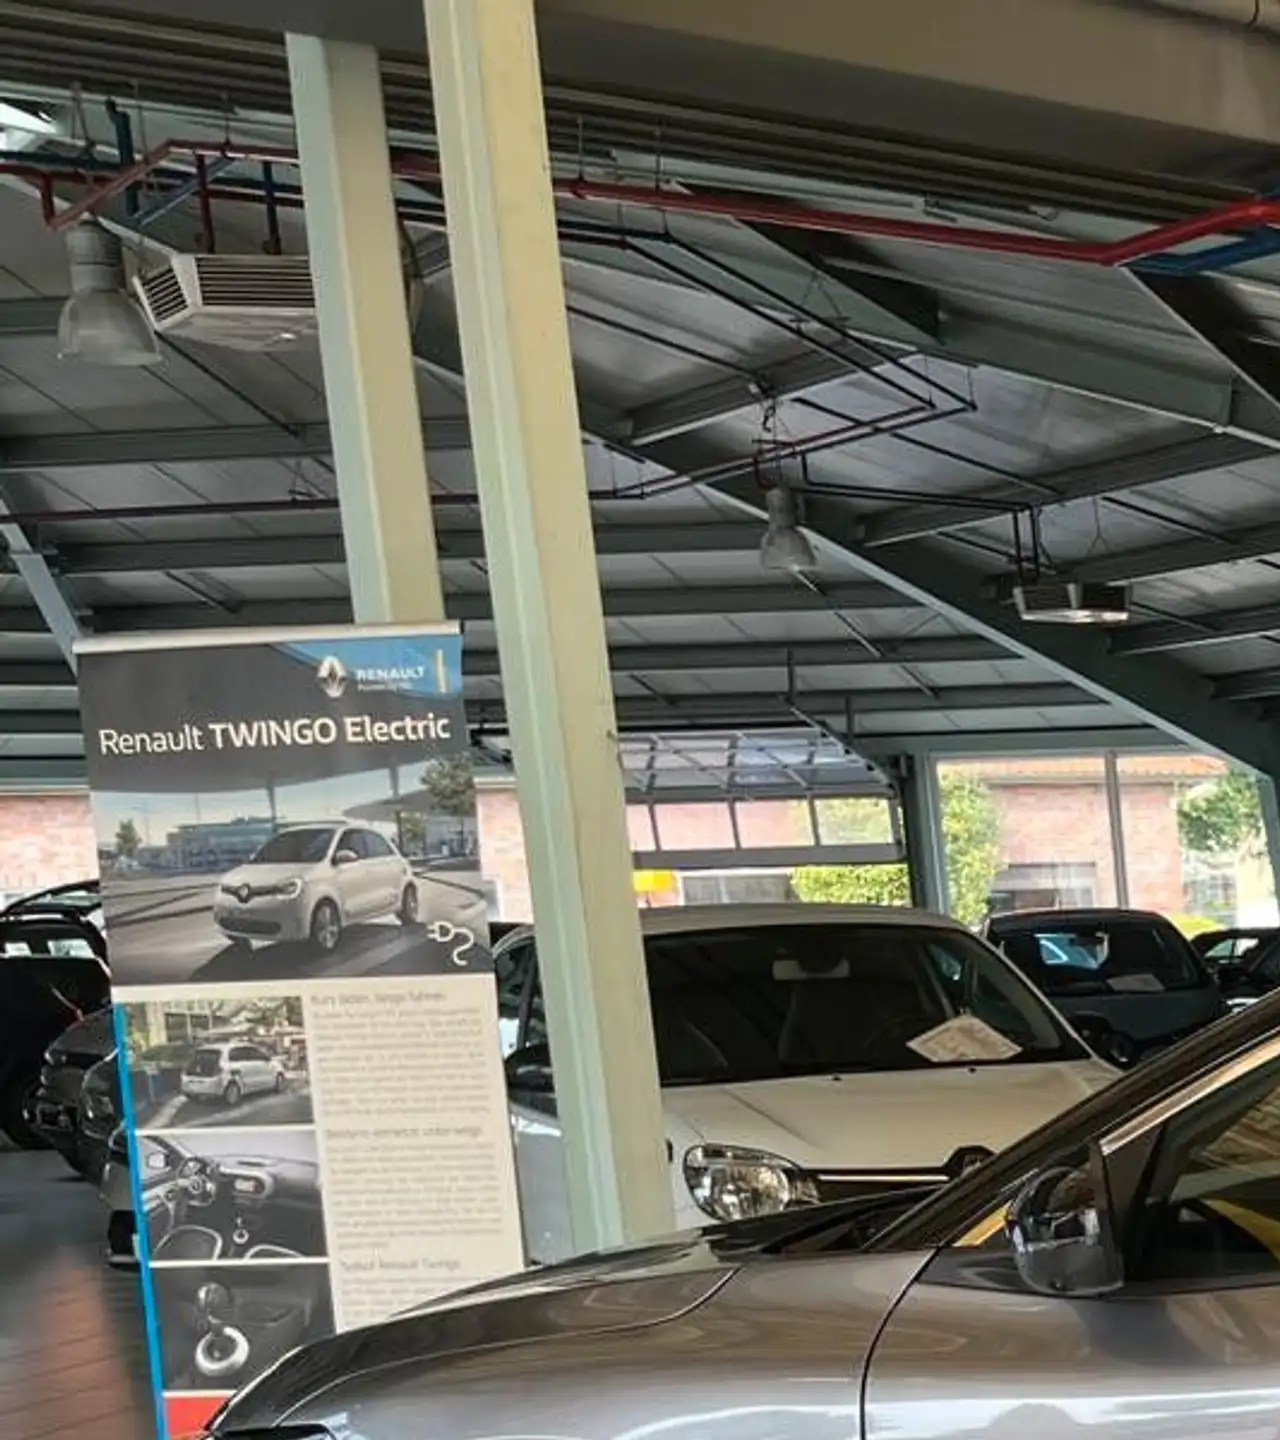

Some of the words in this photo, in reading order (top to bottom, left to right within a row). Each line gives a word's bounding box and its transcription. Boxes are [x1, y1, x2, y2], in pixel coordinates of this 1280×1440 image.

[355, 666, 424, 681] RENAULT
[99, 723, 203, 755] Renault
[208, 717, 337, 749] TWINGO
[344, 713, 451, 744] Electric
